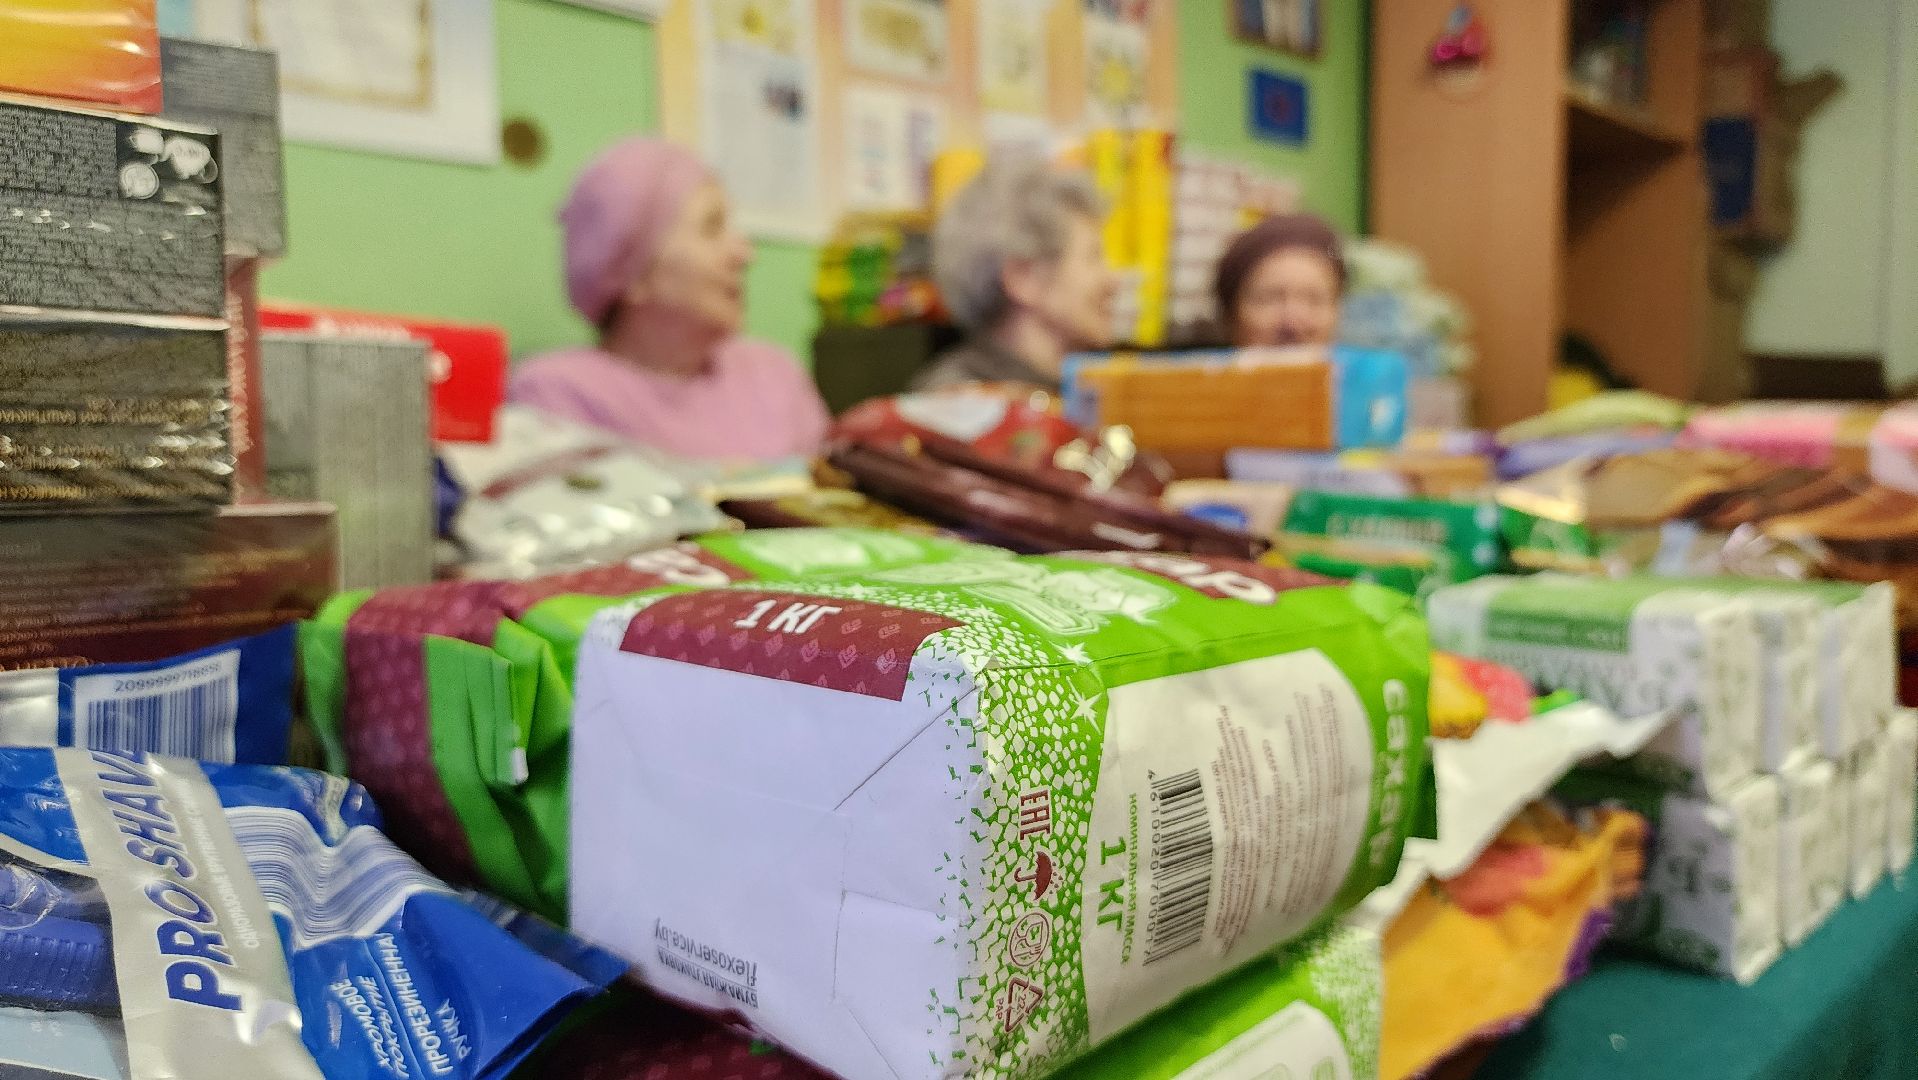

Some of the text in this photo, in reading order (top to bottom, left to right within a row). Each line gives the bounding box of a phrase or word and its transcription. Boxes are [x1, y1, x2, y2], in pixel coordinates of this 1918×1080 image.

[733, 599, 843, 634] 1 КГ
[1097, 836, 1126, 931] 1 КГ
[1120, 793, 1138, 965] НОМИНАЛЬНАЯ МАССА
[144, 879, 243, 1011] PRO
[655, 917, 758, 987] flexoservice.by
[329, 979, 393, 1070] ХРОМОВОЕ
[356, 976, 410, 1078] ПОКРЫТИЕ
[435, 998, 472, 1060] РУЧКА
